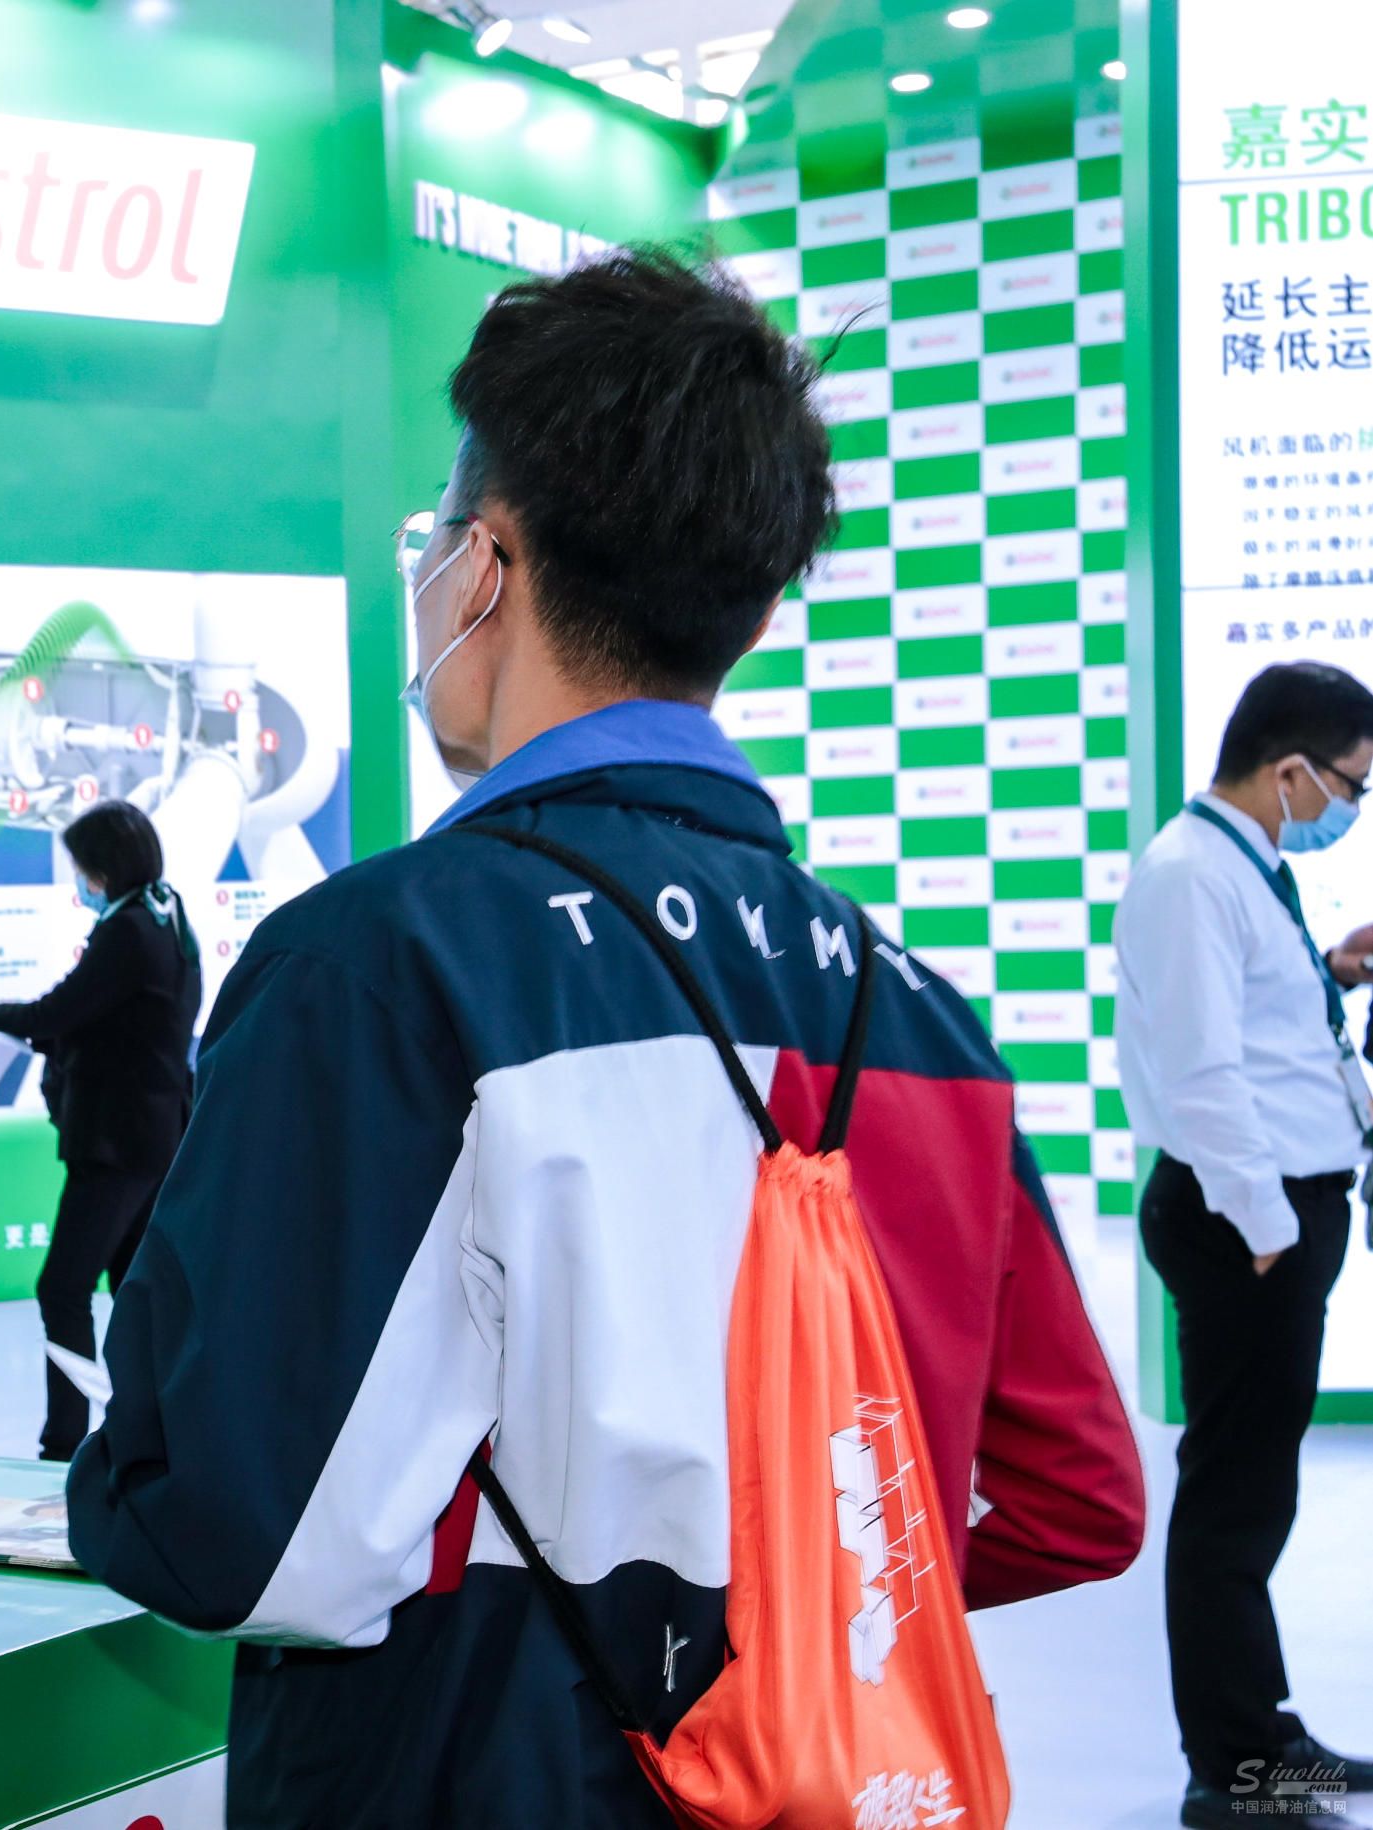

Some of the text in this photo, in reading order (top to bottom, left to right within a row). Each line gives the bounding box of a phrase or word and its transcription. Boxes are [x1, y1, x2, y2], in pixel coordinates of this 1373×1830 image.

[1222, 98, 1368, 169] 嘉实
[1222, 273, 1371, 322] 延长主
[1223, 327, 1371, 376] 降低运
